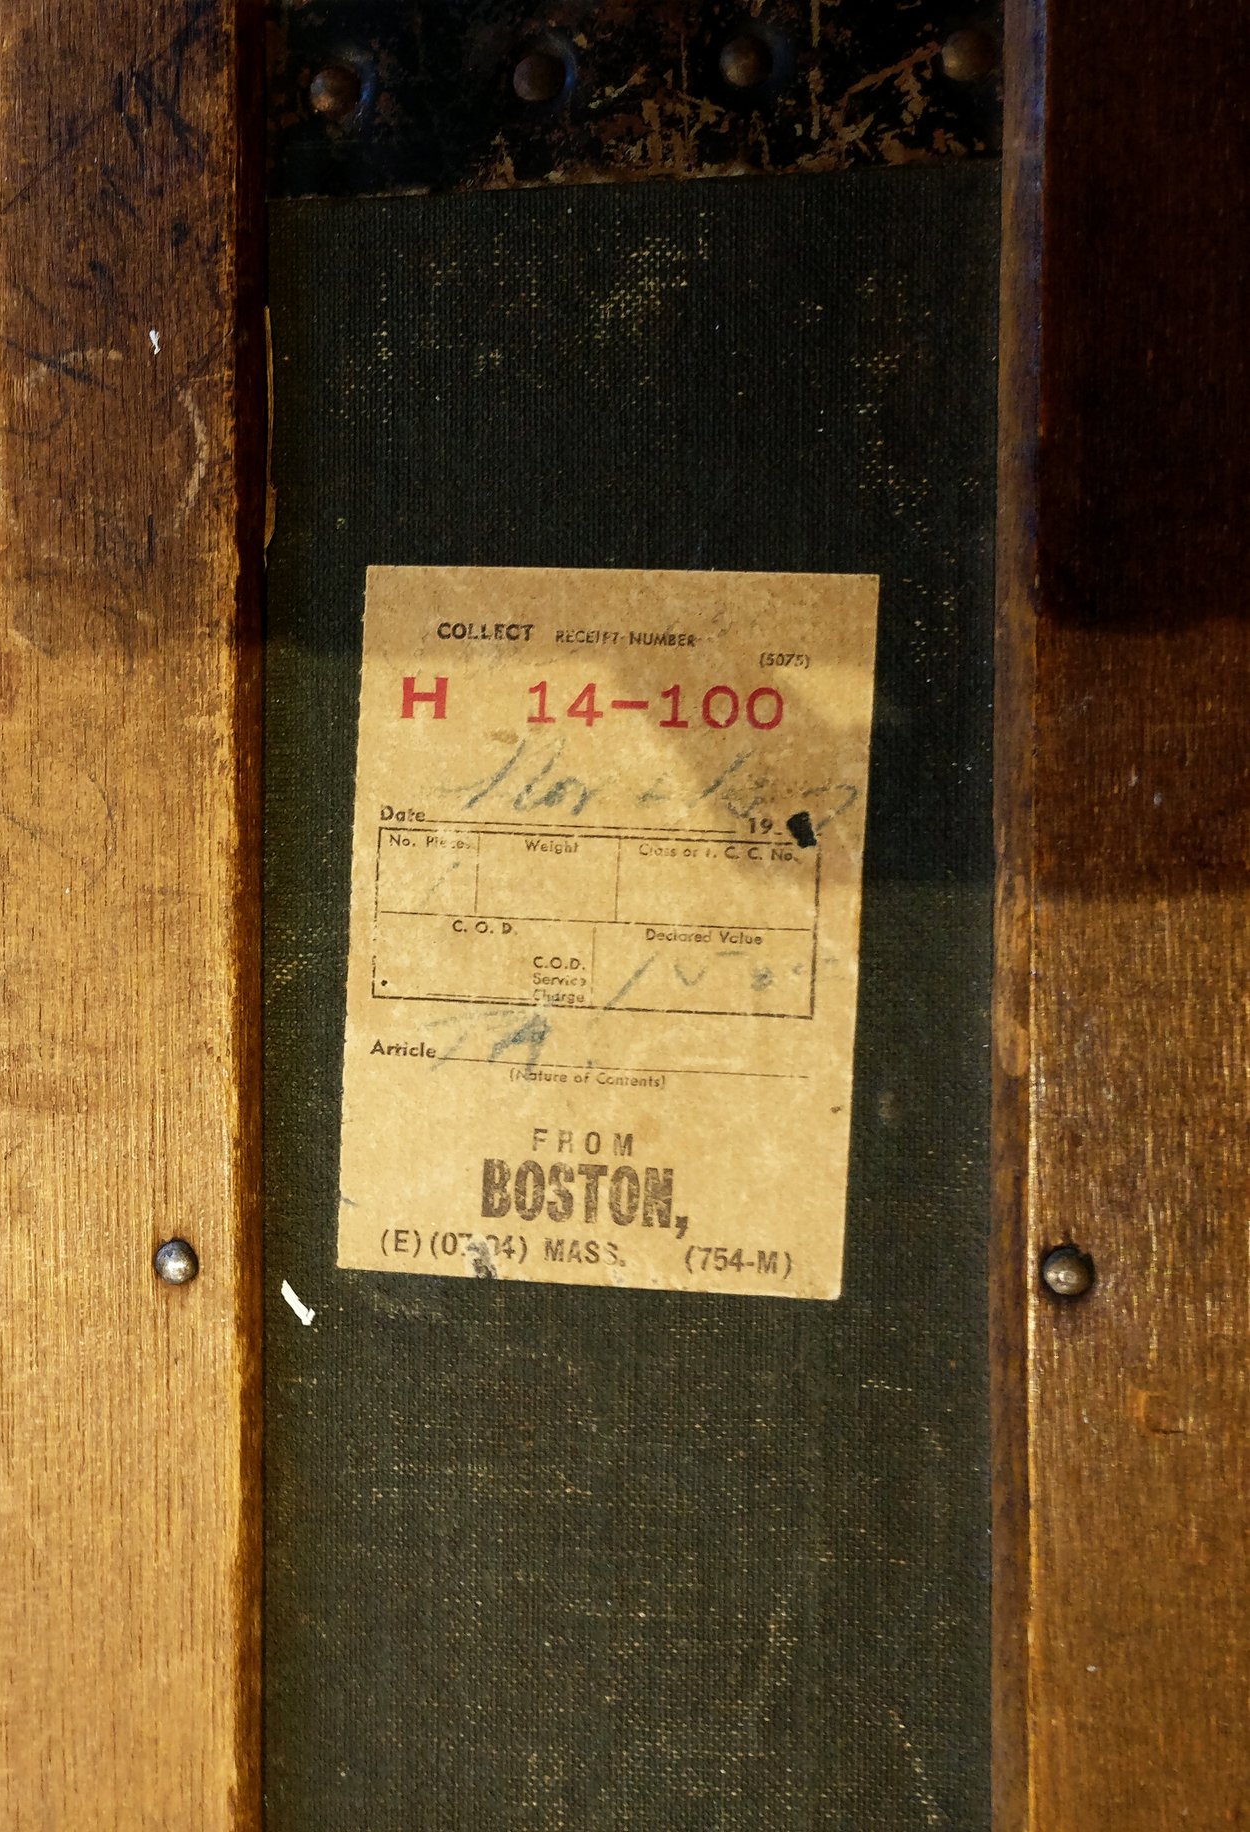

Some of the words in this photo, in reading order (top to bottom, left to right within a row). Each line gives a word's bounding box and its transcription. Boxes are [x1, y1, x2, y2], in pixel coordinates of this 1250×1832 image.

[436, 621, 535, 642] COLLECT
[629, 630, 696, 648] NUMBER
[401, 676, 449, 720] H
[526, 680, 785, 732] 14-100
[380, 805, 426, 822] Date
[389, 834, 417, 847] No.
[525, 839, 579, 854] Weight
[645, 929, 712, 944] Declared
[719, 931, 763, 946] Value
[532, 955, 587, 971] C.O.D.
[532, 972, 587, 987] Service
[369, 1040, 437, 1059] Article
[573, 1070, 590, 1085] of
[531, 1127, 635, 1157] FROM
[481, 1157, 690, 1239] BOSTON,
[543, 1236, 627, 1268] MASS.
[684, 1244, 793, 1280] (754-M)
